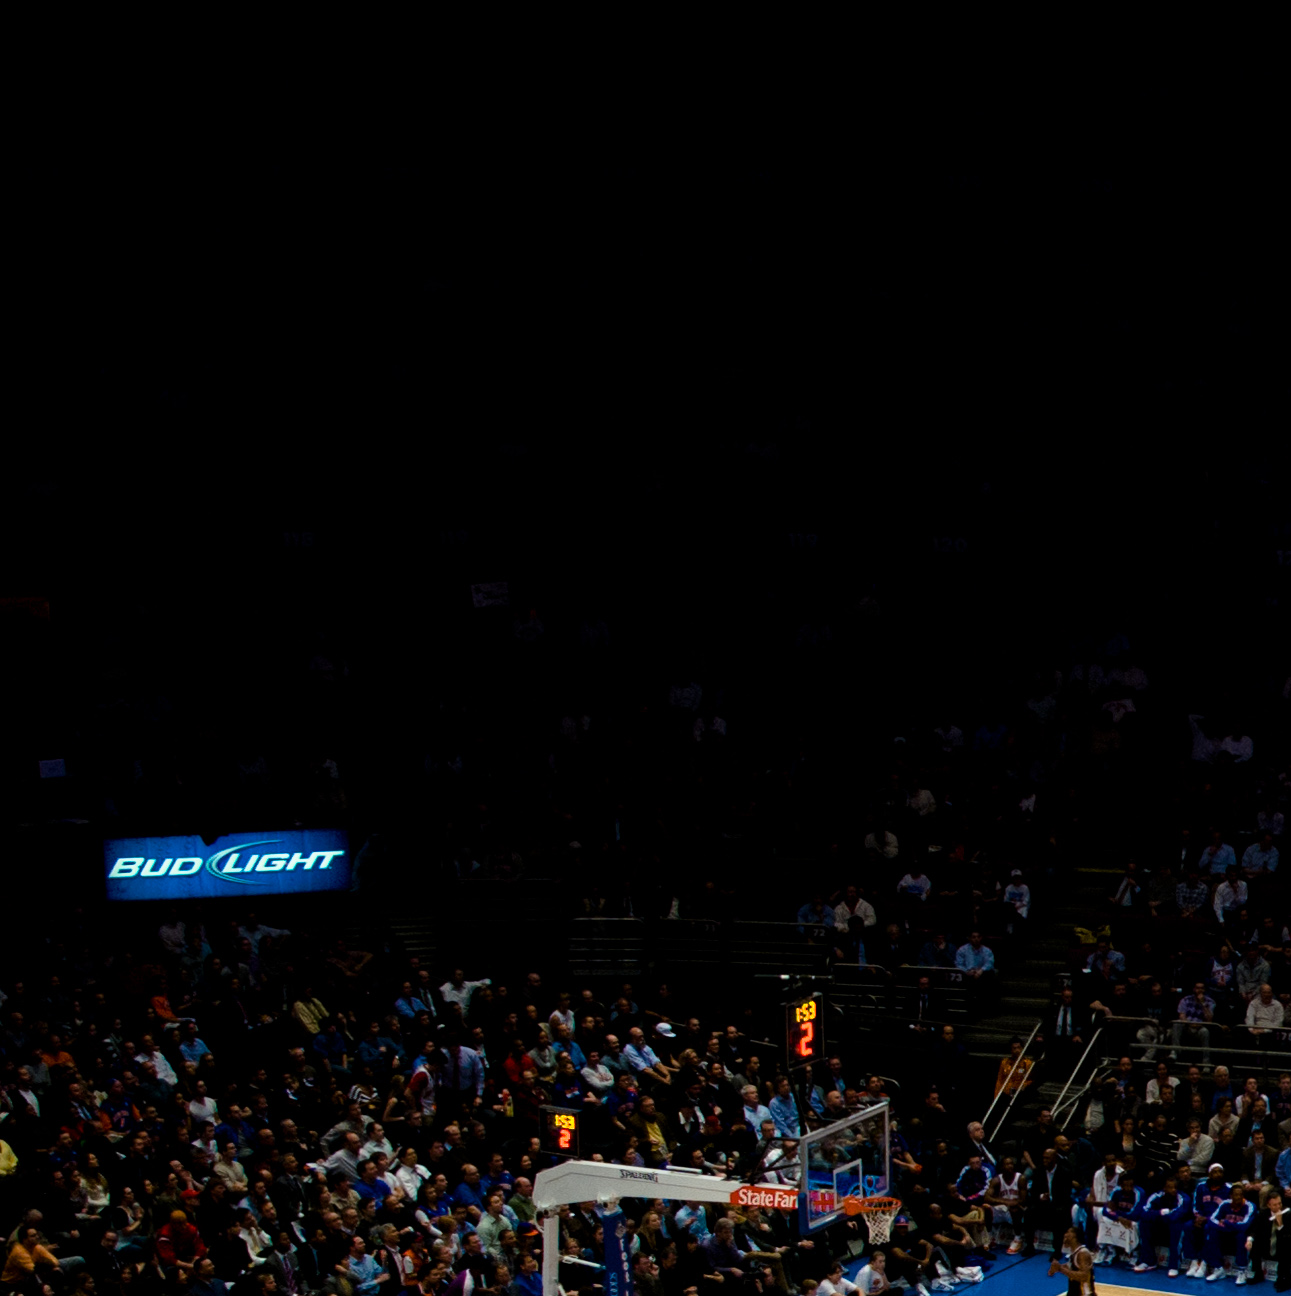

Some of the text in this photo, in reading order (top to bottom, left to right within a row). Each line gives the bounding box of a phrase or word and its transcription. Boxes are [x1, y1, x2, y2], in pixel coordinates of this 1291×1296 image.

[108, 850, 345, 879] BUD LIGHT
[800, 1022, 813, 1056] 2
[559, 1129, 571, 1148] 2
[738, 1188, 799, 1209] StateFar
